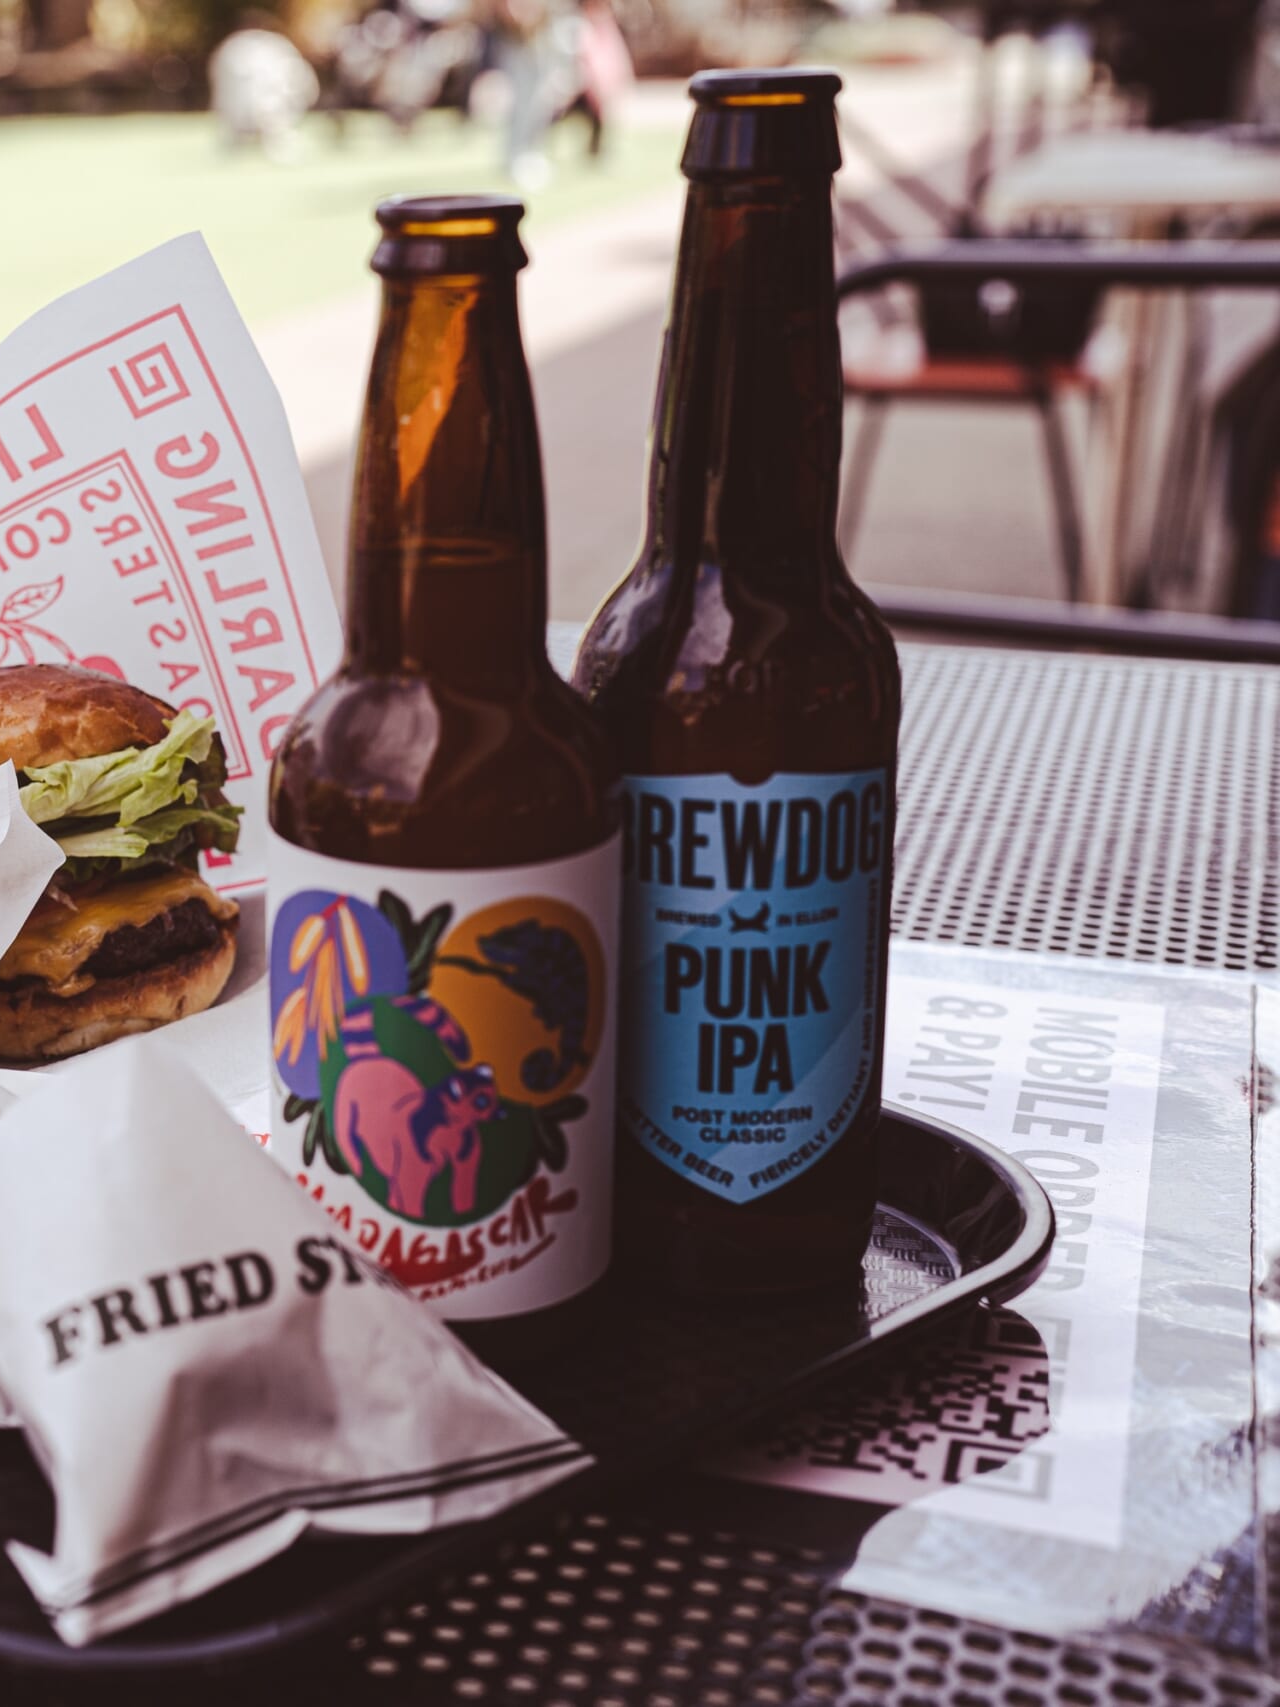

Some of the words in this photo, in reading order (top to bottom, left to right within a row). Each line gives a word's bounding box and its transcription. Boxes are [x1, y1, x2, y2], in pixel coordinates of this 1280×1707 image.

[664, 941, 831, 1019] PUNK
[928, 995, 1009, 1019] &
[697, 1024, 794, 1094] IPA
[898, 1026, 1002, 1111] PAY!
[1012, 1007, 1119, 1144] MOBILE
[672, 1105, 724, 1125] POST
[731, 1105, 812, 1126] MODERN
[700, 1126, 786, 1144] CLASSIC
[749, 1131, 828, 1188] FIERCELY
[827, 1059, 870, 1132] DEFIANT
[683, 1152, 734, 1187] BEER
[43, 1250, 275, 1368] FRIED
